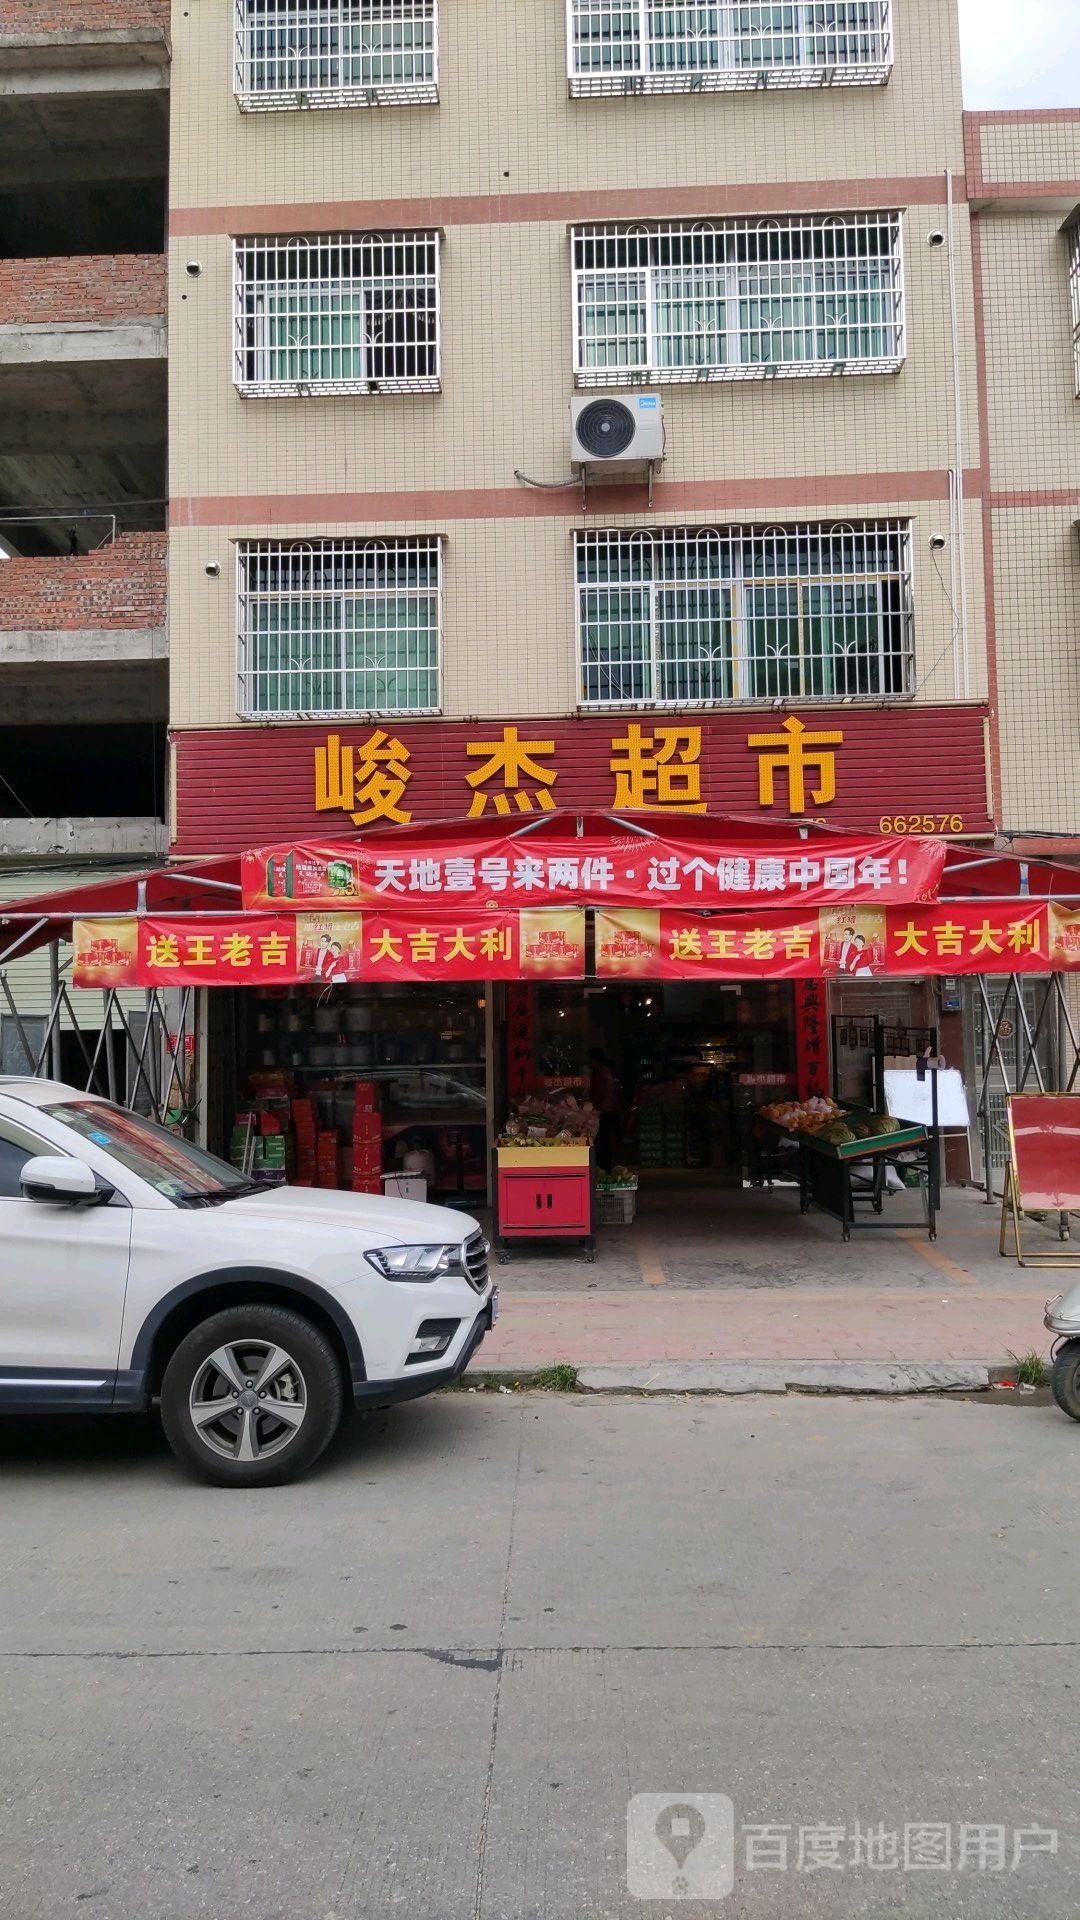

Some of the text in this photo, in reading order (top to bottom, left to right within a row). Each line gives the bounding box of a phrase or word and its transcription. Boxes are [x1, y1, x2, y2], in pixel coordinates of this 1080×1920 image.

[315, 715, 843, 826] 峻杰超市
[879, 815, 964, 834] 662576
[145, 929, 291, 969] 送王老吉
[369, 926, 512, 964] 大吉大利
[669, 926, 814, 962] 送王老吉
[893, 918, 1041, 957] 大吉大利
